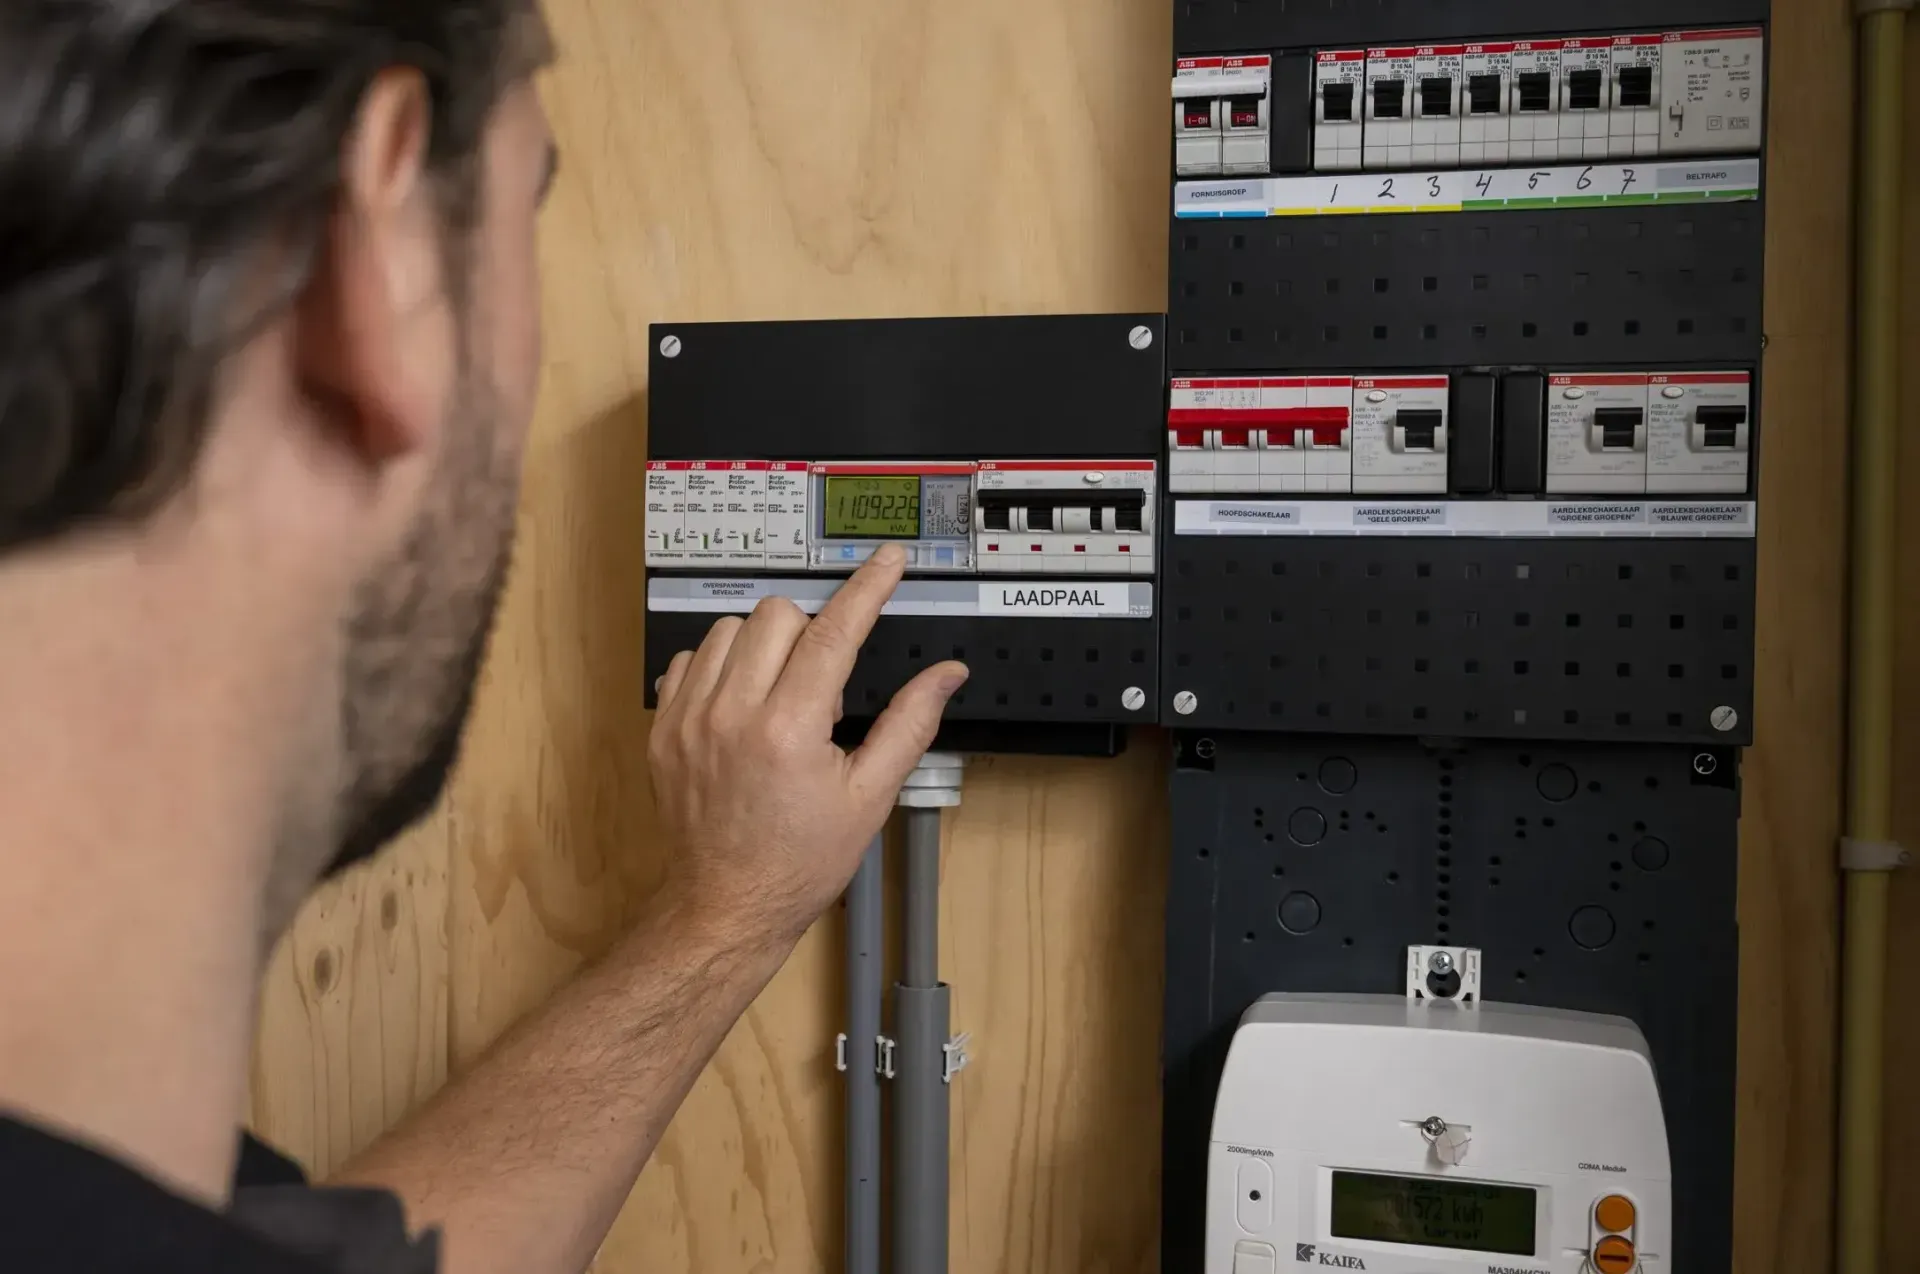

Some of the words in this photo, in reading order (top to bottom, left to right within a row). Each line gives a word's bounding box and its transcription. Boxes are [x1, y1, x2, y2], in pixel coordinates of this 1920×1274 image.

[1476, 173, 1492, 196] 4
[1528, 171, 1550, 190] 5
[1576, 165, 1592, 190] 6
[1622, 169, 1636, 194] 7
[1686, 172, 1727, 181] BELTRAFO
[1191, 189, 1247, 198] FORNUISGROEP
[1330, 184, 1338, 203] 1
[1377, 178, 1395, 198] 2
[1427, 175, 1441, 197] 3
[651, 462, 667, 470] ABB
[691, 462, 706, 470] ABB
[731, 462, 747, 470] ABB
[1218, 510, 1291, 519] HOOFDSCHAKELAAR
[1357, 508, 1440, 516] AARDLEKSCHAKELAAR
[1552, 506, 1640, 514] AARDLEKSCHAKELAAR
[1003, 590, 1104, 606] LAADPAAL
[1318, 1252, 1366, 1270] KAIFA
